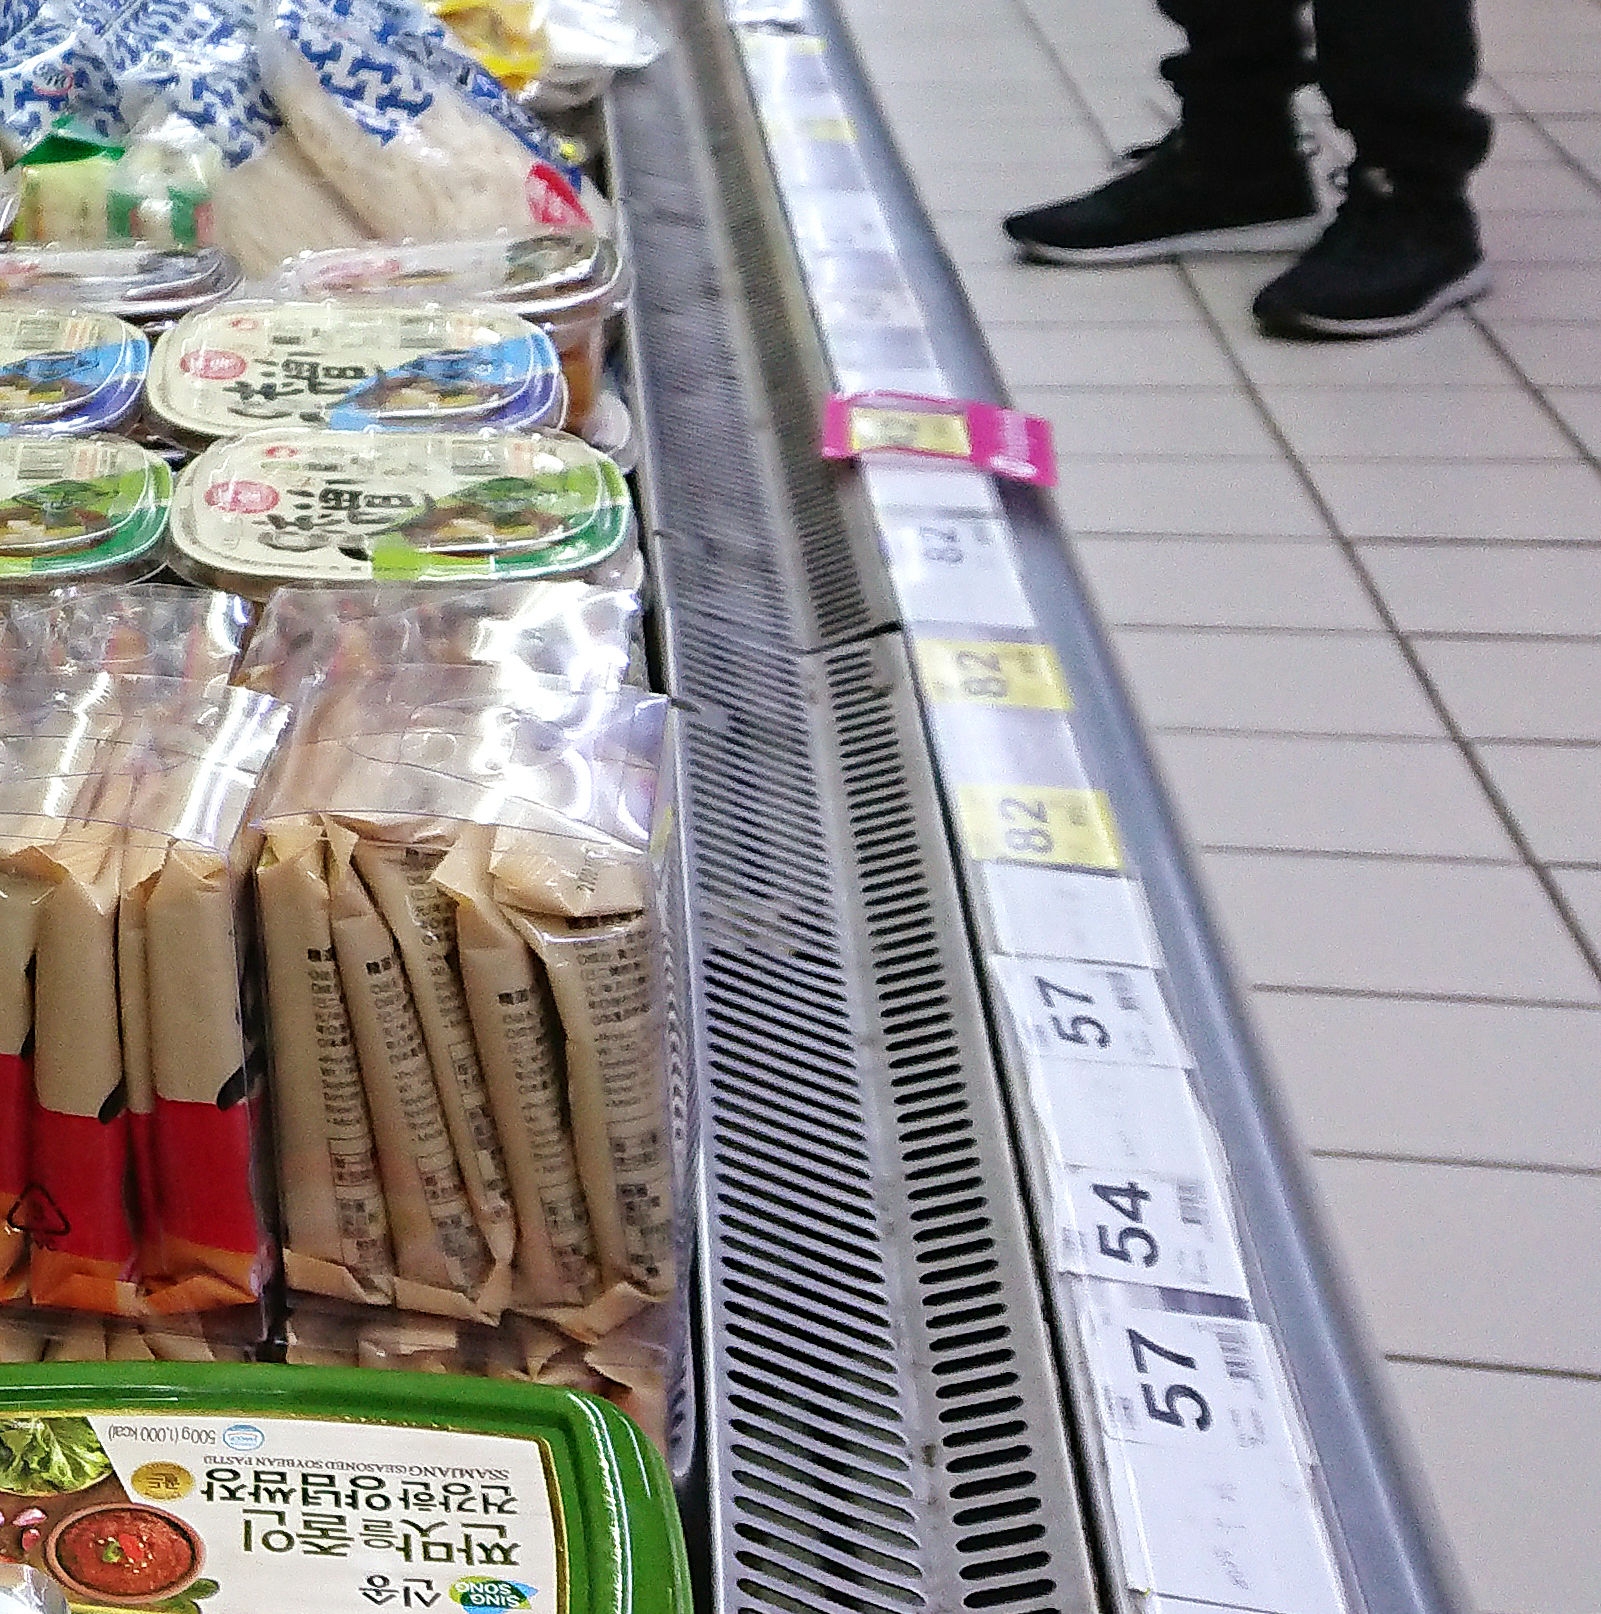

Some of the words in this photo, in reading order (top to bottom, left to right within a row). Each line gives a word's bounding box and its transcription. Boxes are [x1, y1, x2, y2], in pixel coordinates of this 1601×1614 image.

[1000, 794, 1055, 856] 82
[1035, 975, 1112, 1051] 57
[1090, 1179, 1161, 1269] 54
[1127, 1327, 1214, 1434] 57
[199, 1466, 392, 1511] 양념쌈장
[398, 1481, 519, 1515] 건강한
[242, 1509, 352, 1557] 줄인
[366, 1516, 522, 1567] 짠맛을
[358, 1574, 444, 1610] 신송
